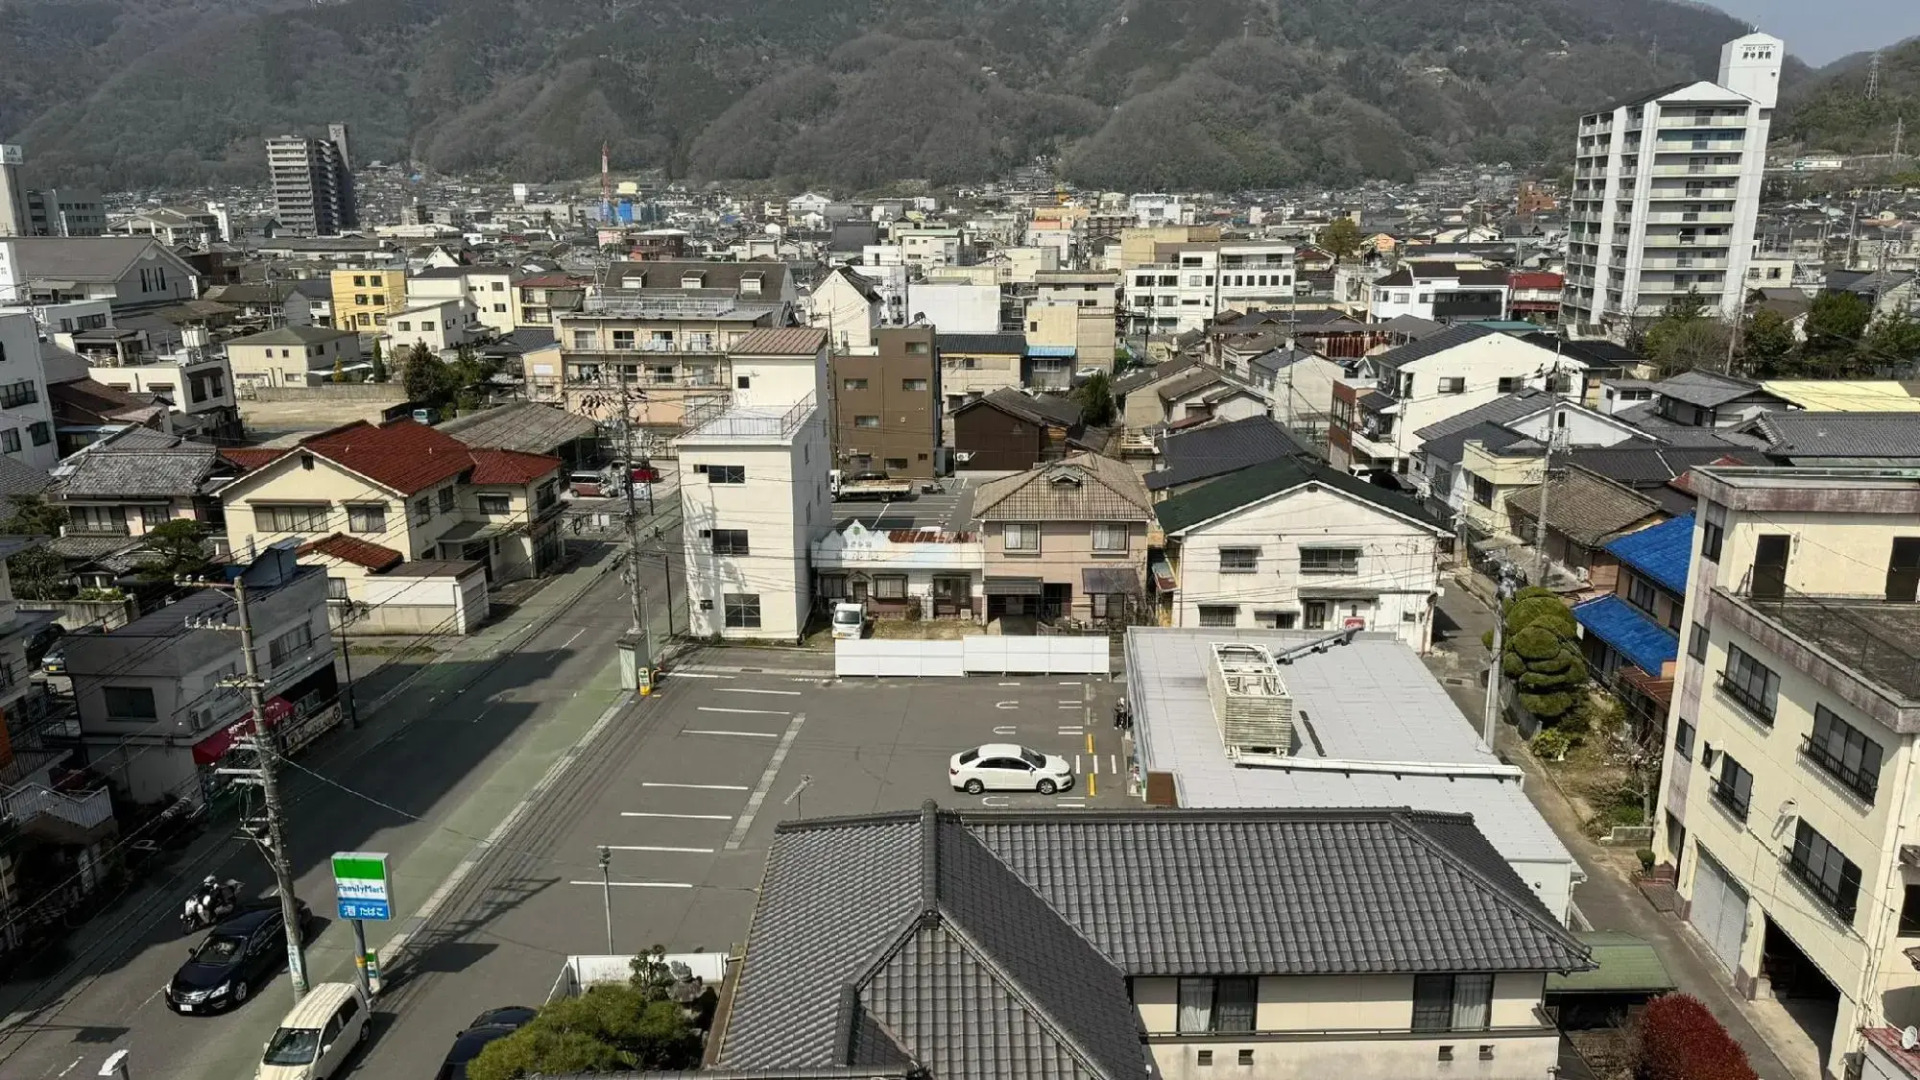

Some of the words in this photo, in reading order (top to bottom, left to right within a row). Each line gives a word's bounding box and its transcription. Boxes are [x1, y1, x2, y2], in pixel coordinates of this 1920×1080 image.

[337, 883, 385, 893] FamilyMart
[360, 907, 384, 917] たばこ
